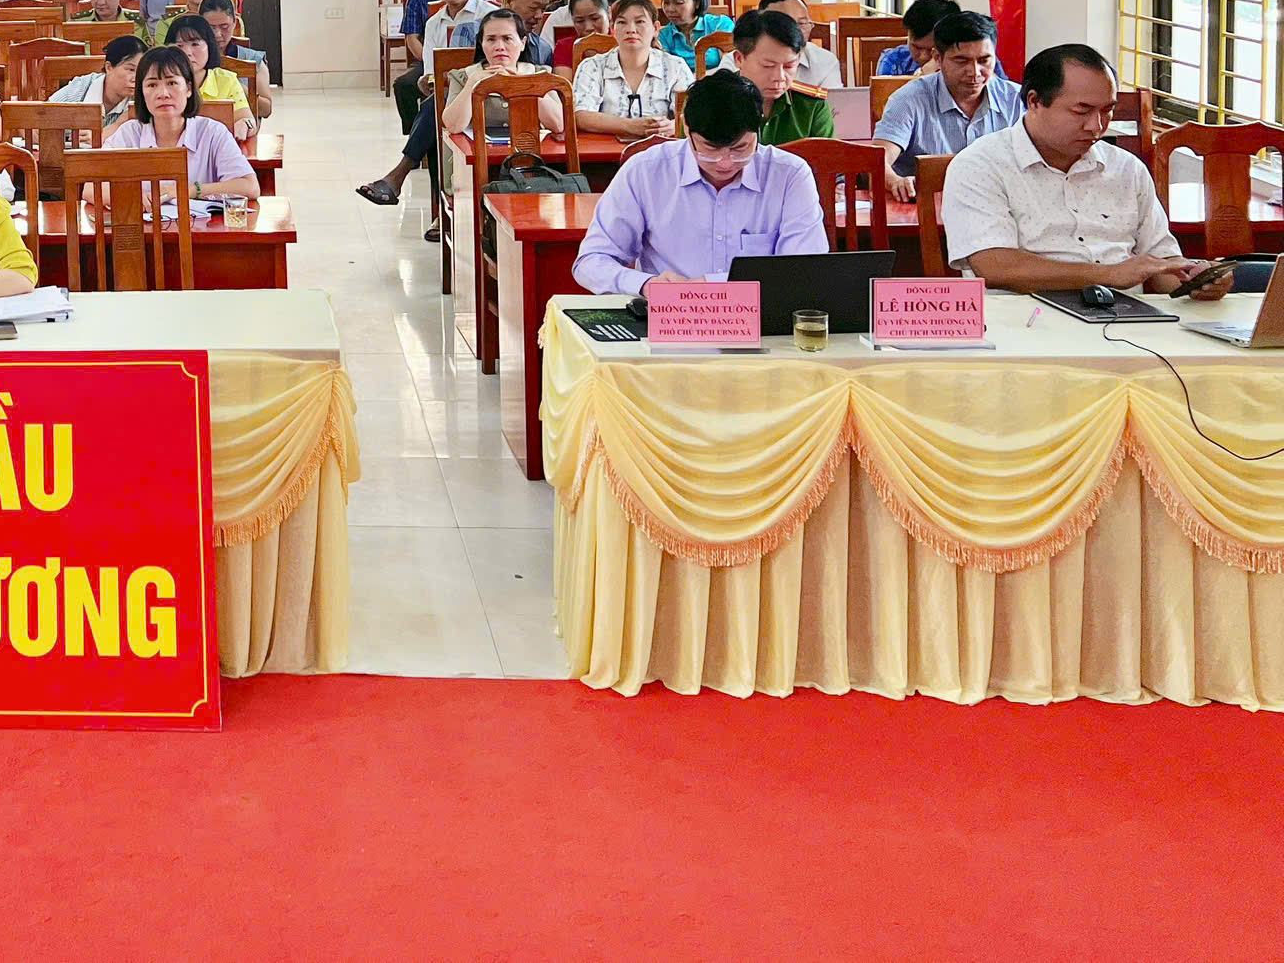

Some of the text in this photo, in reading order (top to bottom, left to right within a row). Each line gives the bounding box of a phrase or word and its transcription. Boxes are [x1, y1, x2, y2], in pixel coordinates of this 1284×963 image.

[934, 286, 950, 294] CHÍ
[710, 291, 727, 299] CHÍ
[879, 298, 978, 312] LÊ HỒNG HÀ
[689, 305, 719, 315] MẠNH
